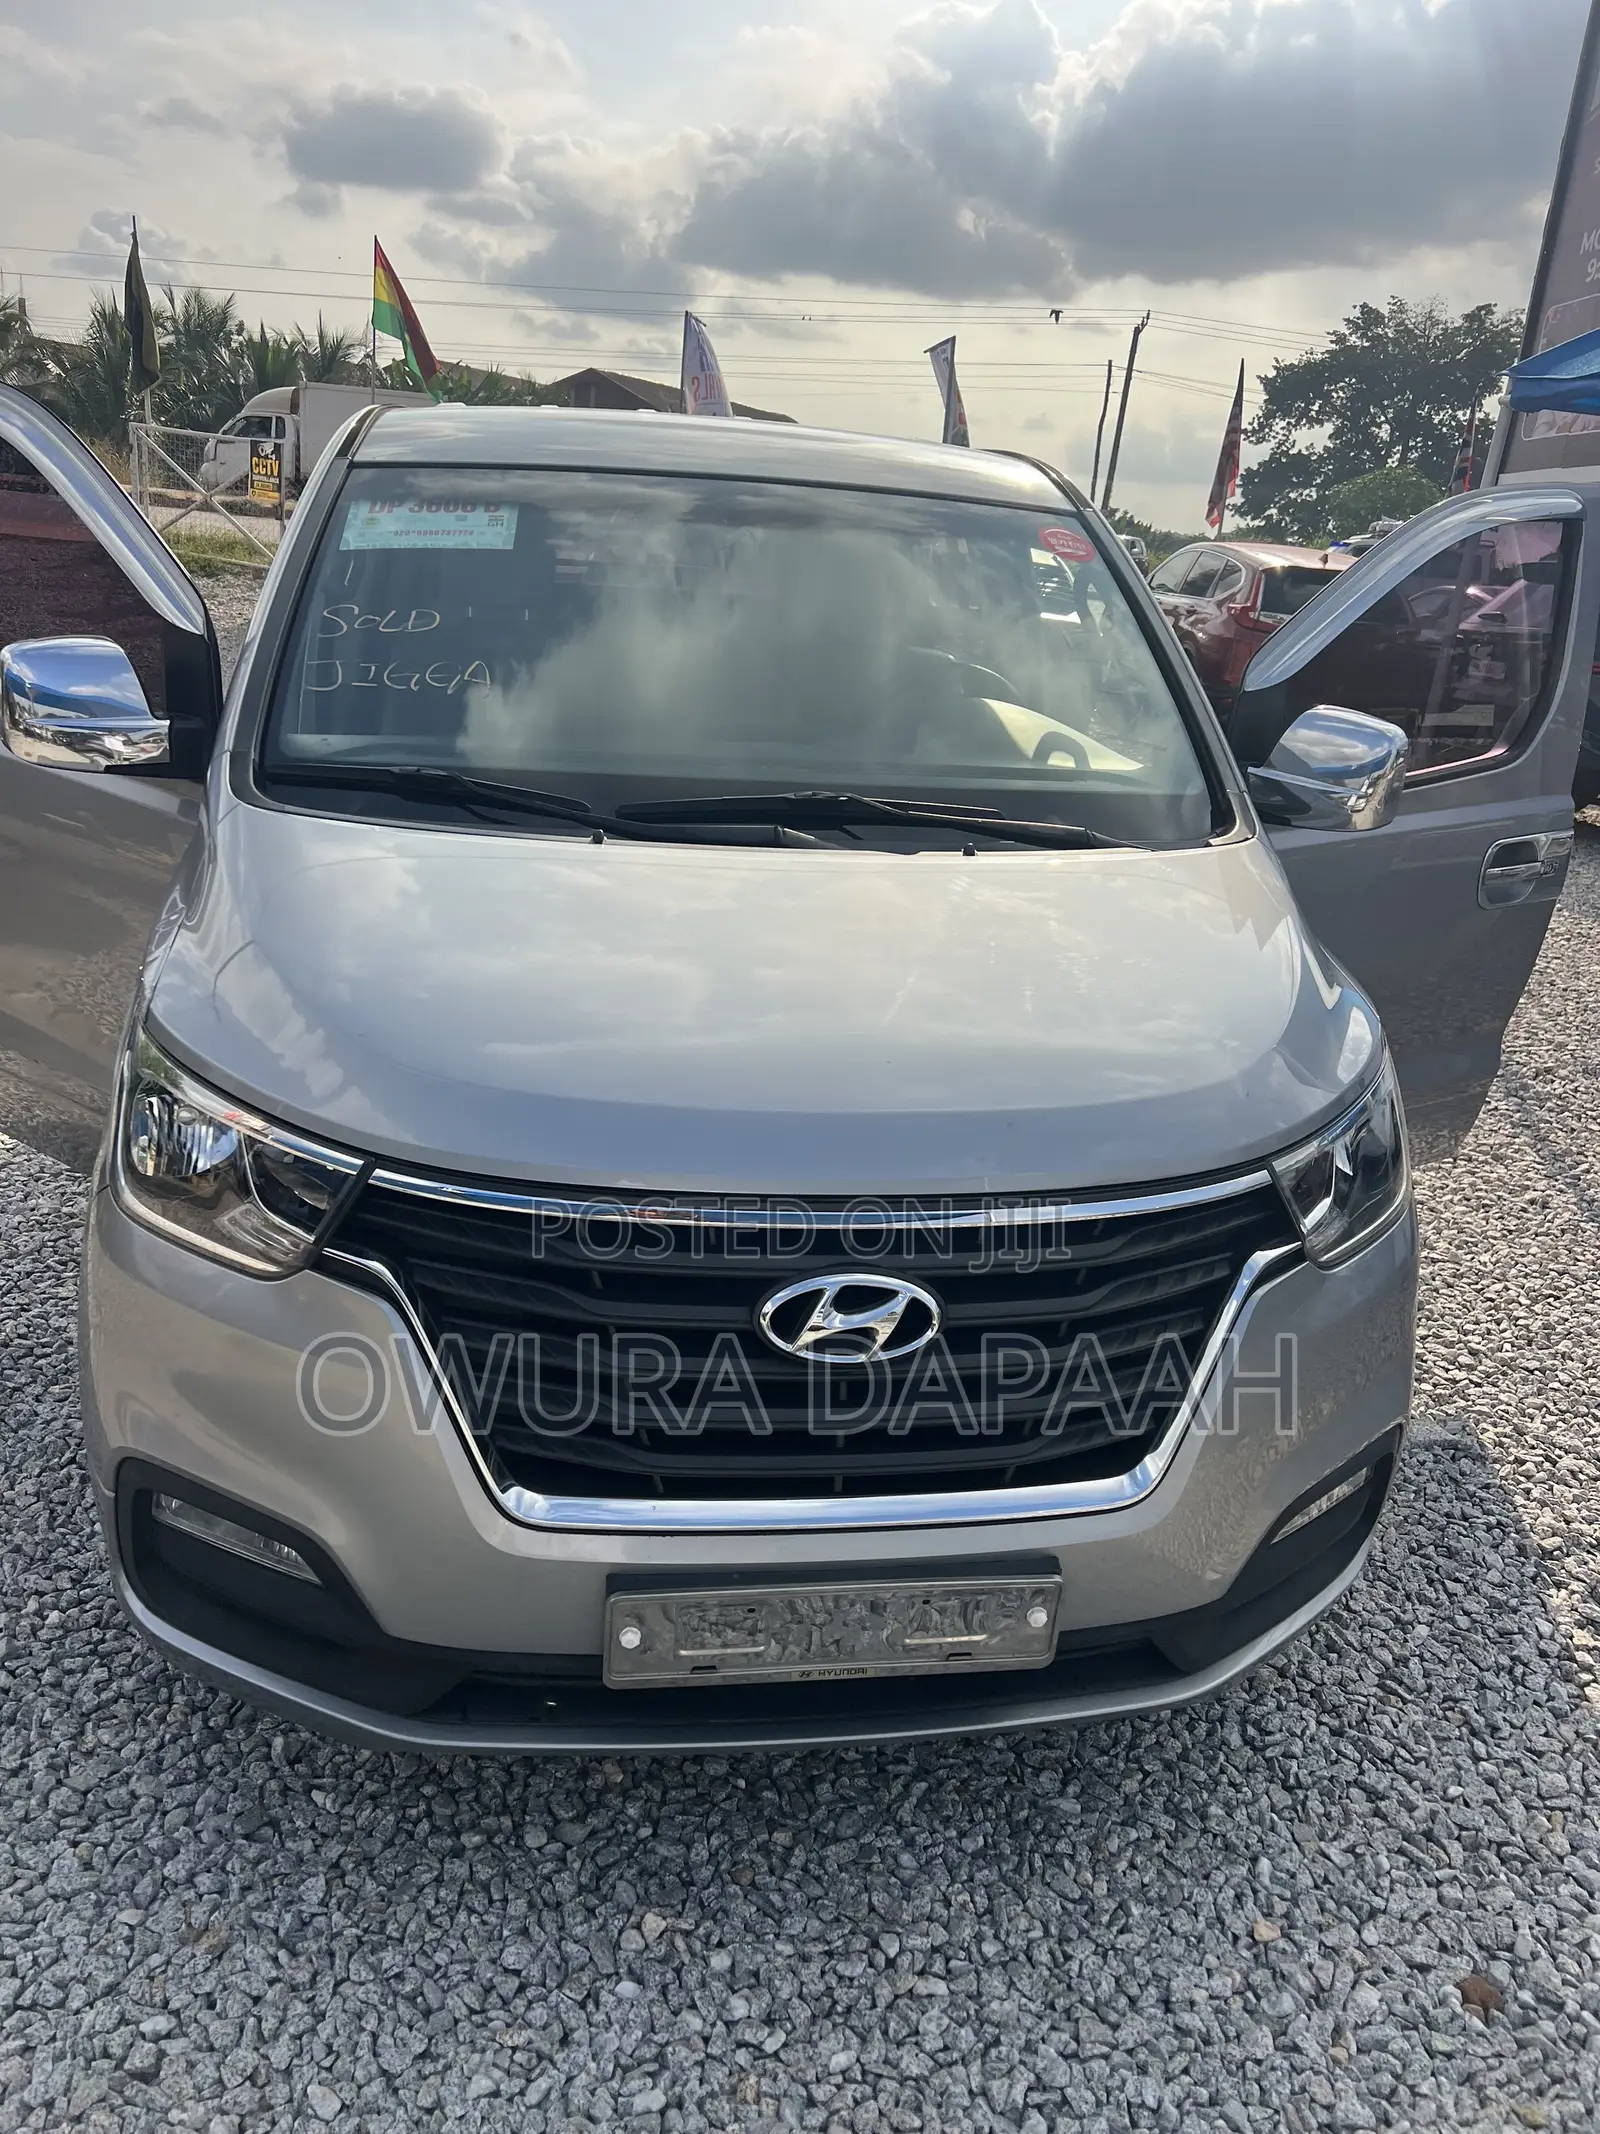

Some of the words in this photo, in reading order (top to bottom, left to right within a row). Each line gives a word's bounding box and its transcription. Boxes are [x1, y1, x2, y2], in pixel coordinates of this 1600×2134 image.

[252, 456, 279, 477] CCTV
[317, 604, 441, 638] SOLD
[817, 1667, 868, 1677] HYUNDAI
